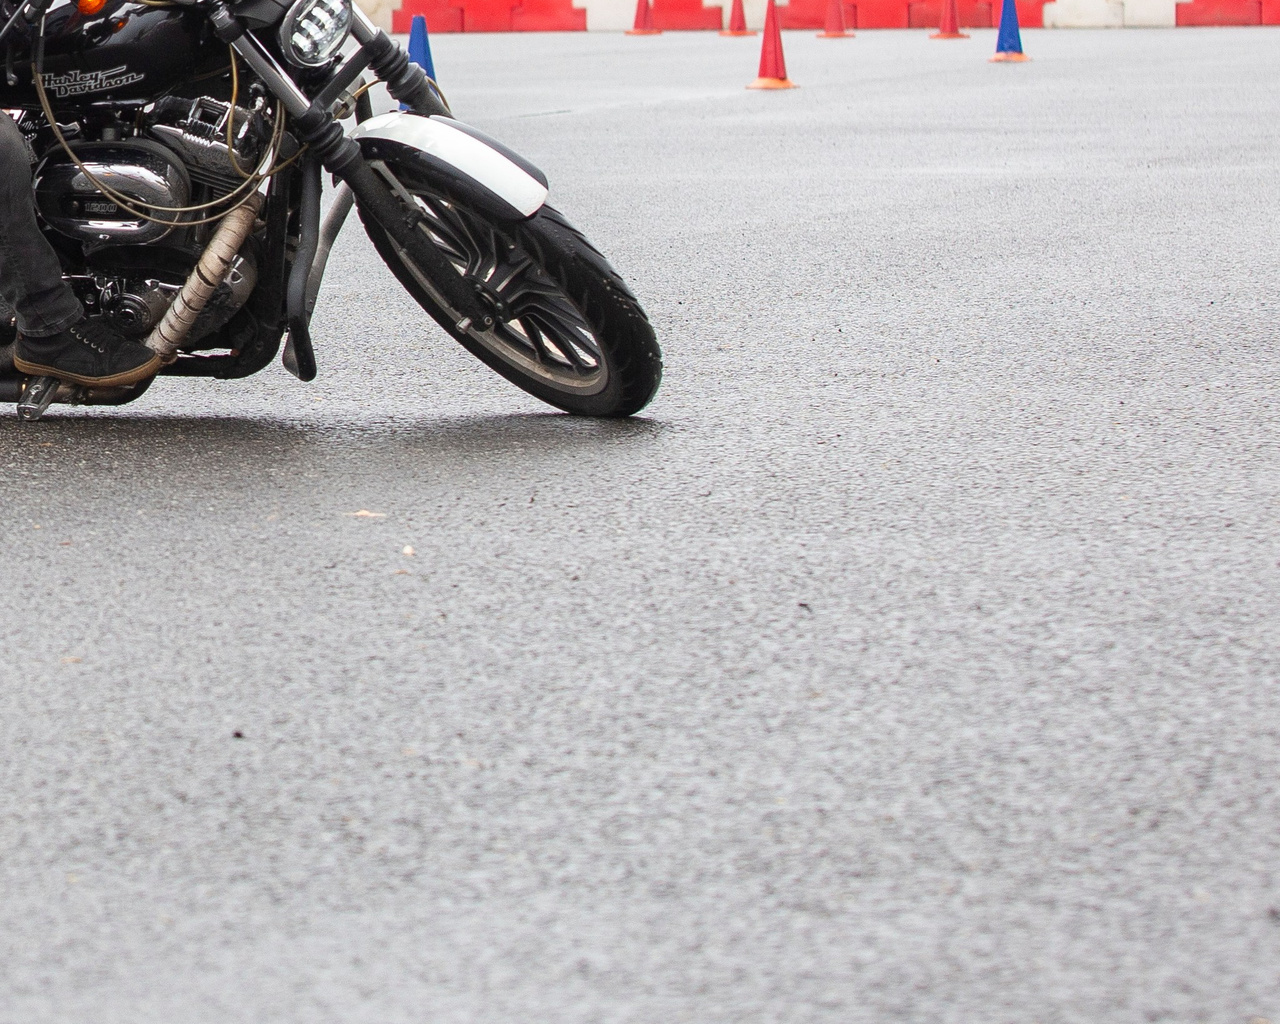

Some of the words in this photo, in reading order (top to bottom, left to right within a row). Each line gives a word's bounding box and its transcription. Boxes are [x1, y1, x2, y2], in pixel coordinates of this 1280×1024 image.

[32, 65, 127, 89] Harley
[56, 73, 145, 97] Davidson
[84, 202, 118, 213] 1200
